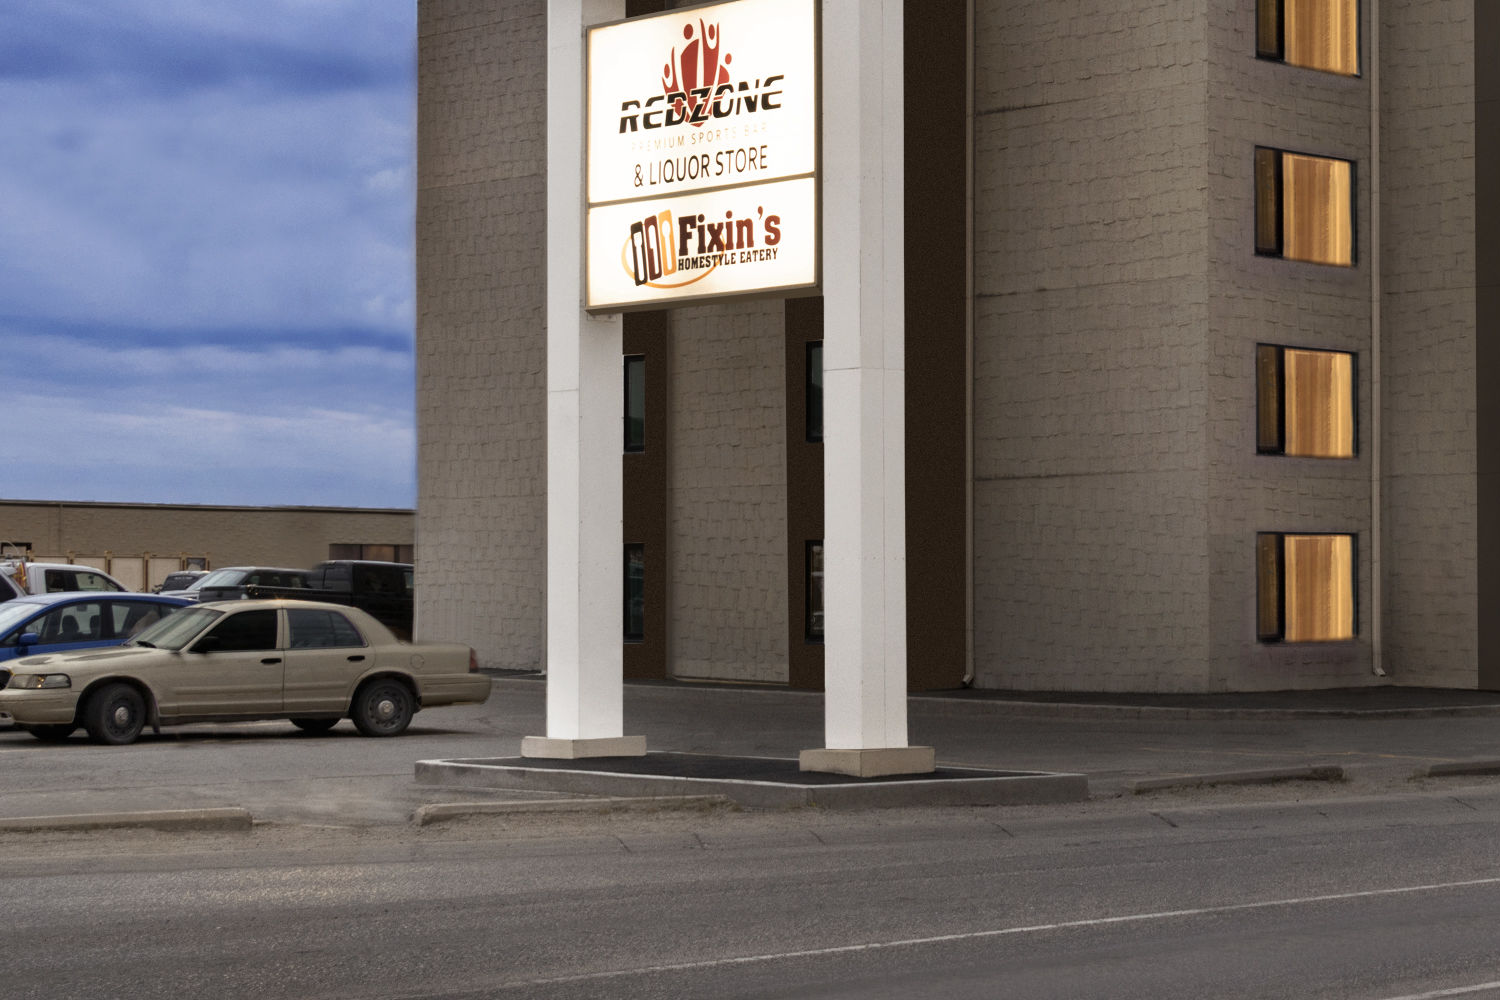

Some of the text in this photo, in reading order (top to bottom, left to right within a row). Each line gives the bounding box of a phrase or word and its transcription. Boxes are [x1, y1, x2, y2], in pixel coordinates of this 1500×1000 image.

[619, 74, 785, 134] REDZONE
[634, 145, 768, 187] & LIQUOR STORE
[678, 205, 781, 257] Fixin's
[678, 247, 778, 271] HOMESTYLE EATERY
